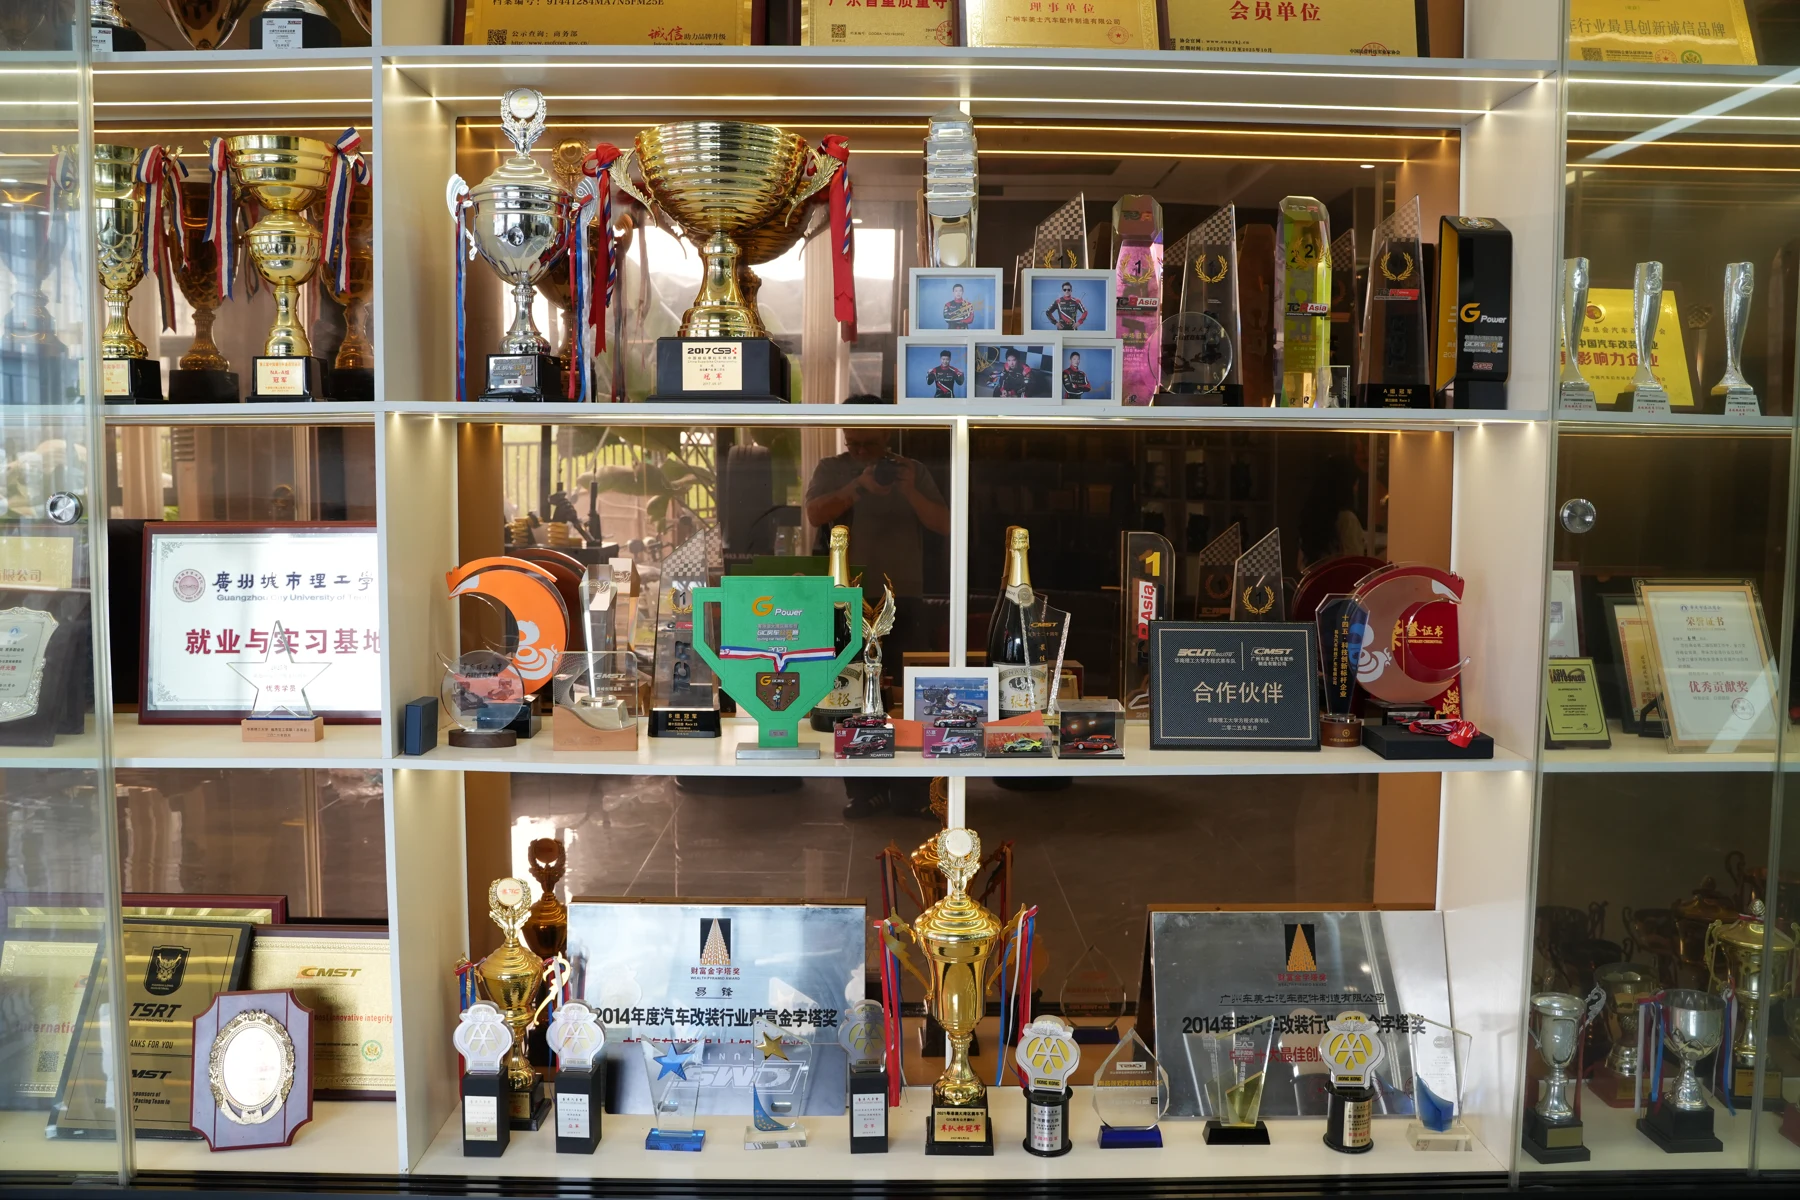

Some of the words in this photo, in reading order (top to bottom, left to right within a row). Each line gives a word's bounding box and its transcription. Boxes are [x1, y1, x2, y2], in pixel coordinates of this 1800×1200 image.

[1030, 2, 1094, 13] 理事单位
[1229, 1, 1321, 21] 会员单位
[1006, 16, 1120, 25] 广州车美士汽车配件制造有限公司
[1305, 244, 1313, 258] 2
[1134, 260, 1141, 274] 1
[1287, 303, 1308, 312] TCR
[1460, 303, 1480, 322] G
[1481, 315, 1507, 323] Power
[1146, 551, 1161, 576] 1
[0, 569, 42, 582] 限公司
[290, 594, 335, 602] University
[680, 592, 685, 605] 1
[1141, 584, 1155, 621] Asia
[752, 596, 774, 616] G
[775, 608, 803, 616] Power
[1686, 616, 1724, 627] 荣誉证书
[1193, 681, 1283, 704] 合作伙伴
[1689, 681, 1749, 693] 优秀贡献奖
[301, 967, 362, 978] CMST
[691, 967, 740, 975] 财富金字塔奖
[1278, 973, 1327, 981] 财富金字塔奖
[1221, 993, 1385, 1003] 广州车美士汽车配件制造有限公司
[130, 1003, 182, 1018] TSRT
[365, 1014, 393, 1023] integrity
[597, 1006, 838, 1027] 2014年度汽车改装行业财富金字塔奖
[130, 1040, 145, 1048] ANKS
[132, 1070, 172, 1079] MST
[941, 1124, 981, 1132] 车队杯冠军
